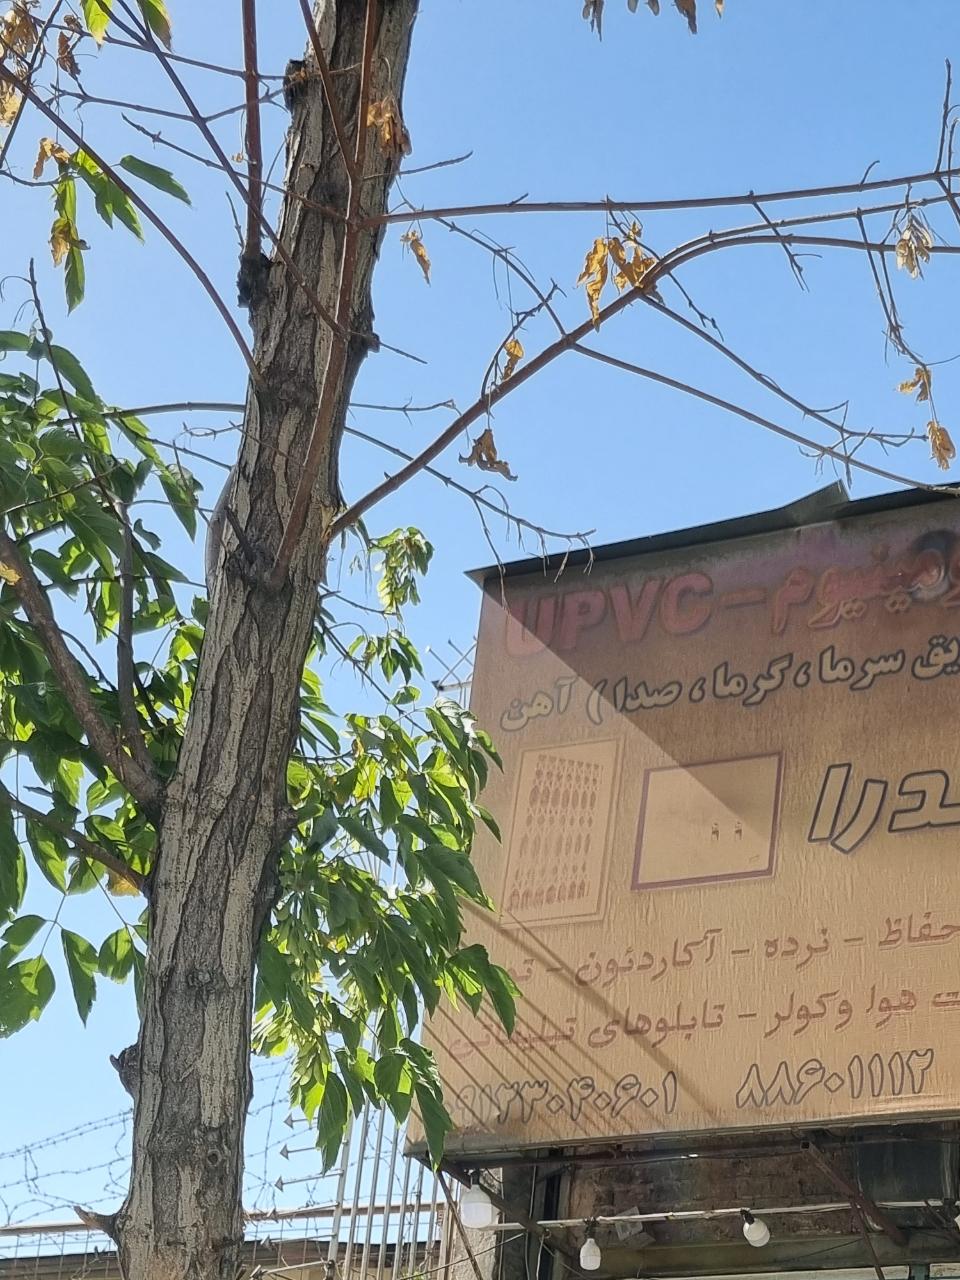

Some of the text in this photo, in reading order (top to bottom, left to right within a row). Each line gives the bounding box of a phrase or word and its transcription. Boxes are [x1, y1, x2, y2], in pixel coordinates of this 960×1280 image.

[505, 571, 713, 657] UPVC
[575, 928, 723, 988] آکاردئون
[764, 927, 831, 970] نرده
[587, 1000, 726, 1049] تابلوهای
[865, 983, 918, 1028] هوا
